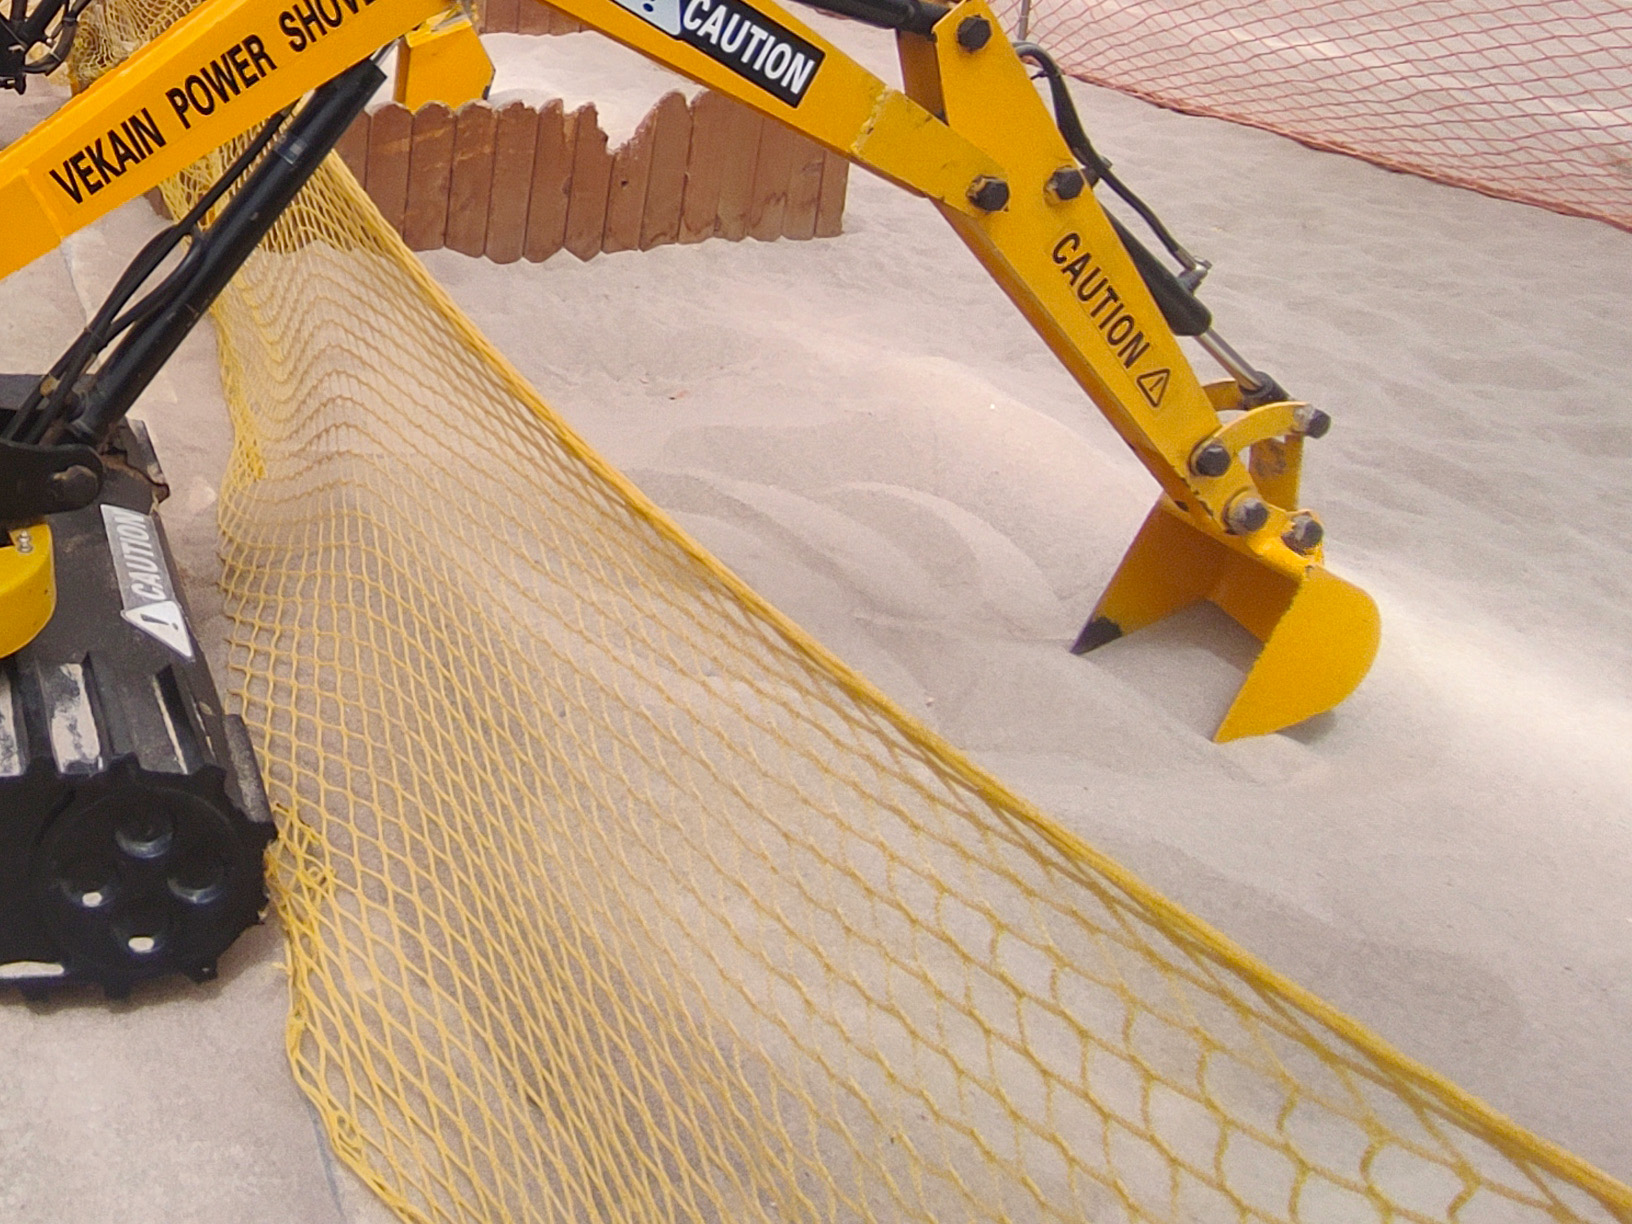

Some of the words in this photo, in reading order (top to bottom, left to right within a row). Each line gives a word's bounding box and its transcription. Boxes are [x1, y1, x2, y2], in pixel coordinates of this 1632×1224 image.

[49, 107, 167, 204] VEKAIN
[165, 34, 278, 130] POWER
[1052, 232, 1151, 370] CAUTION
[114, 510, 167, 601] CAUTION
